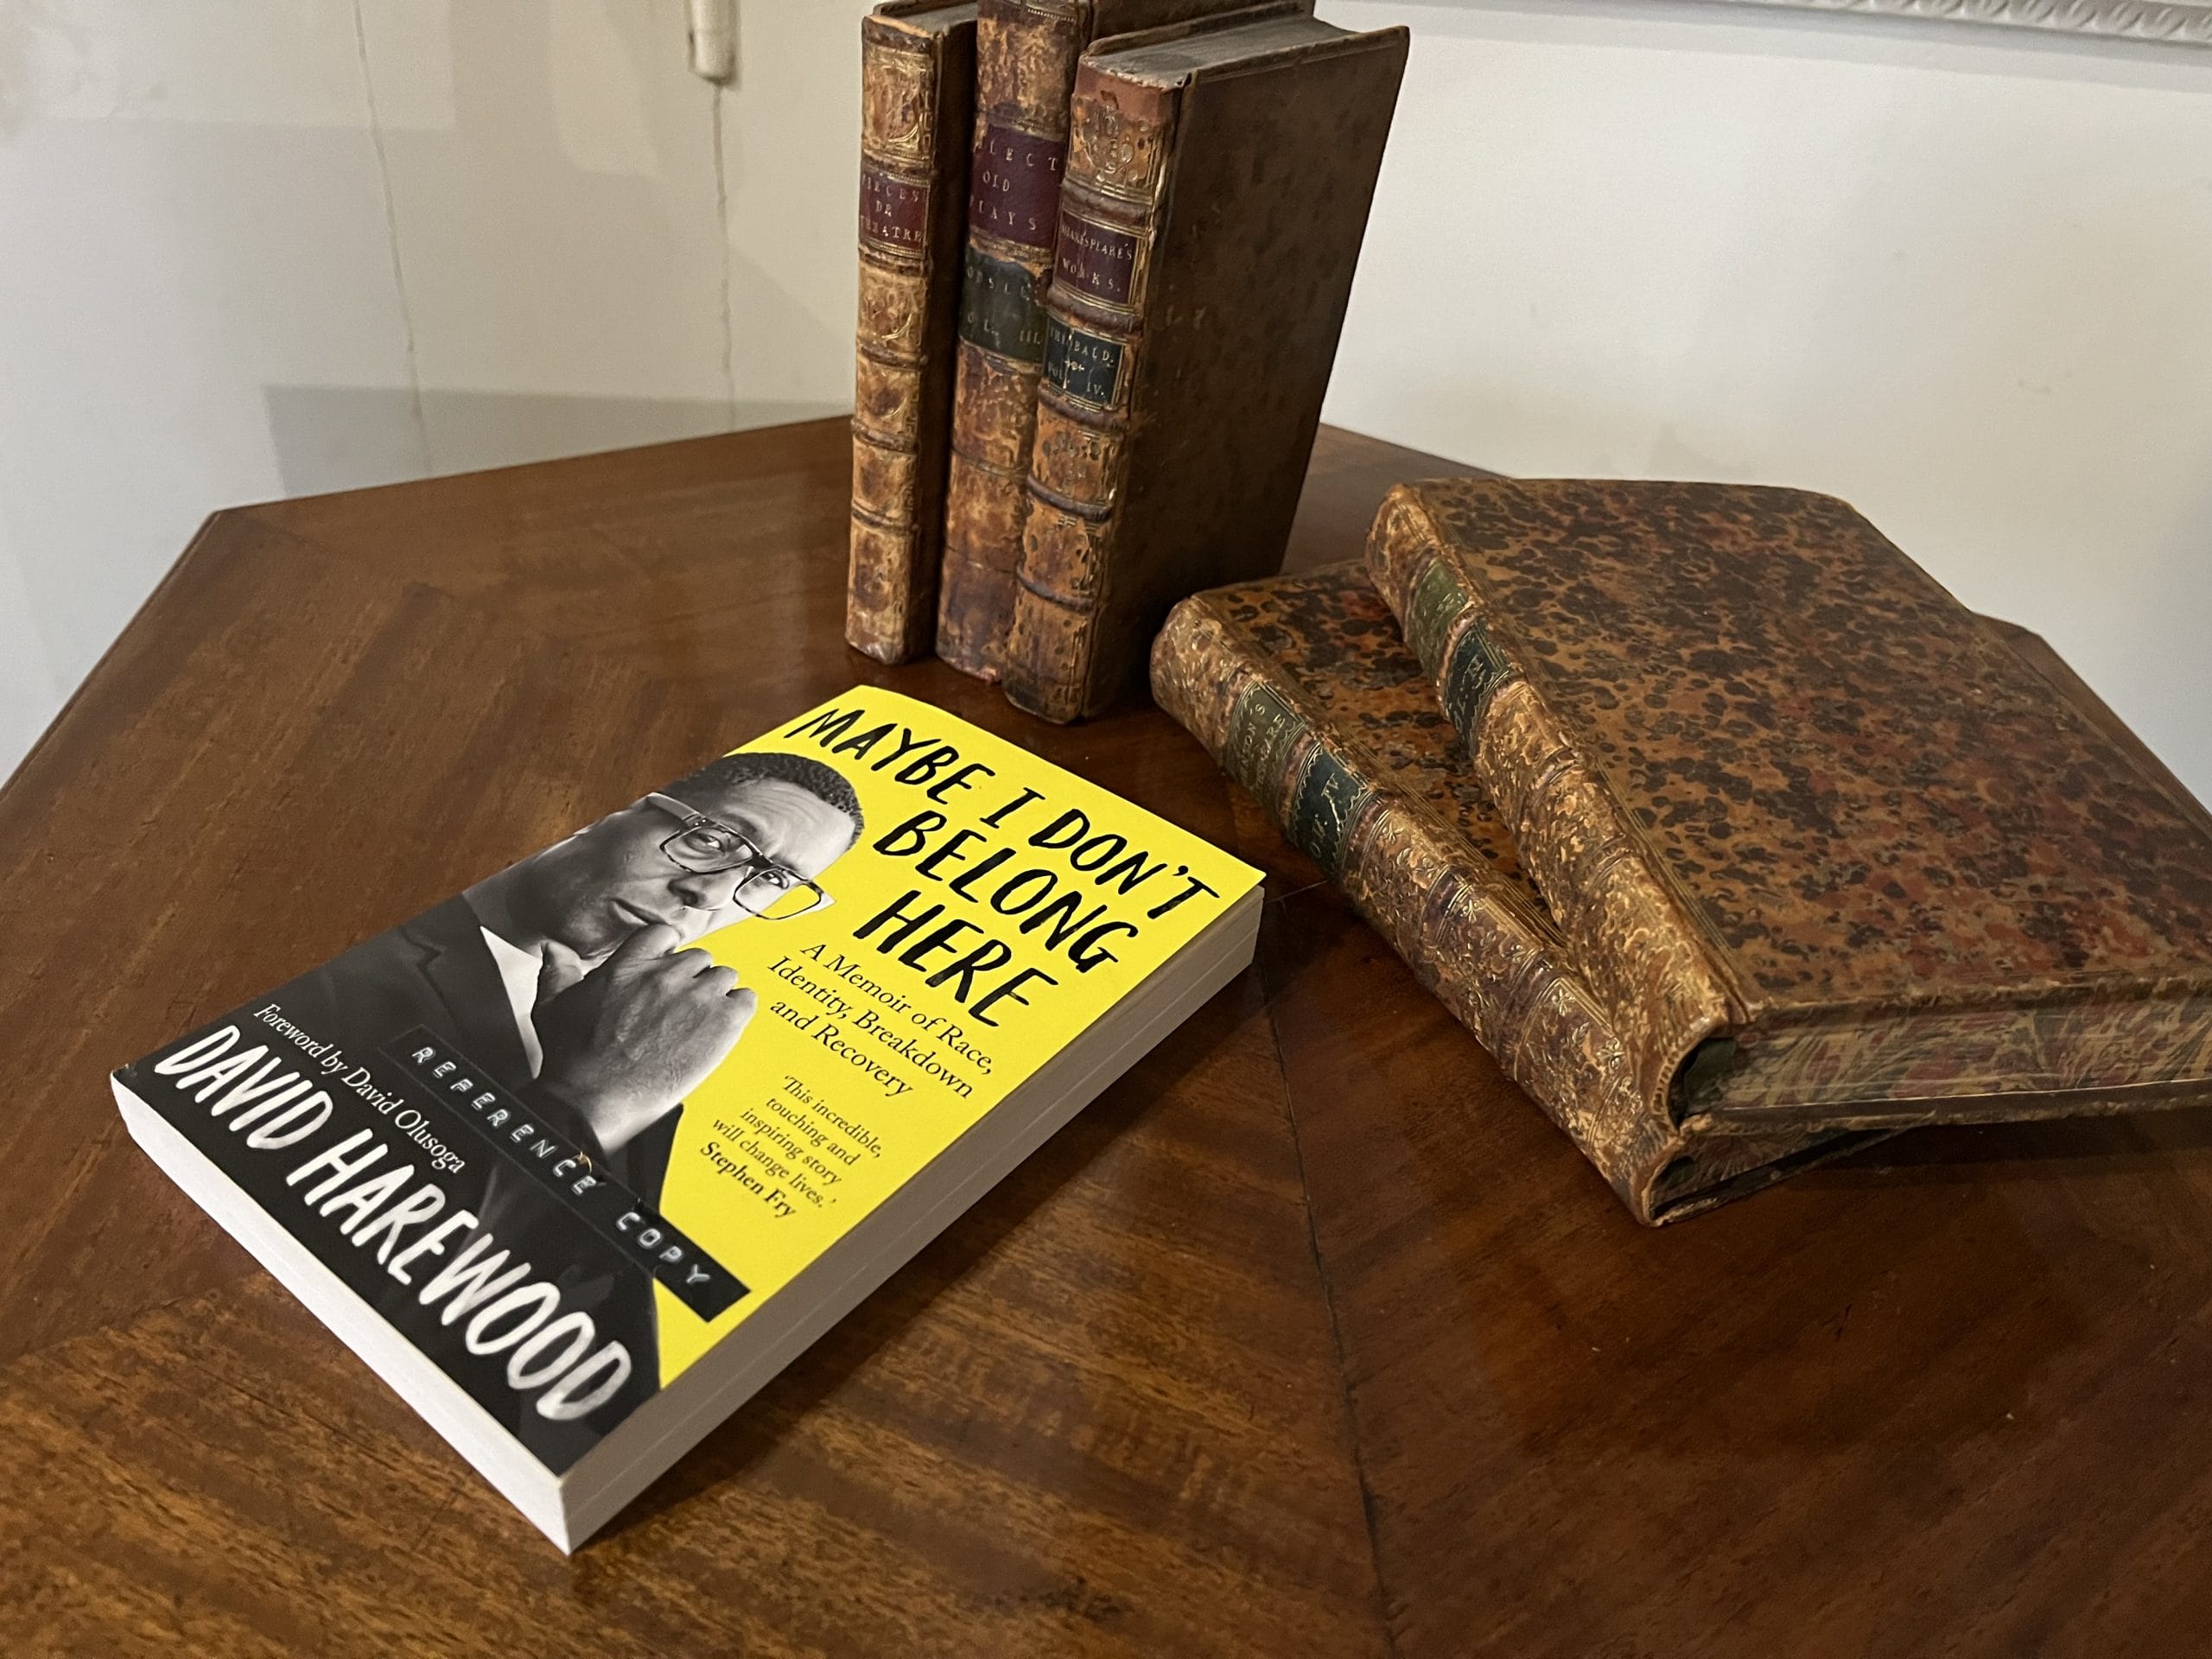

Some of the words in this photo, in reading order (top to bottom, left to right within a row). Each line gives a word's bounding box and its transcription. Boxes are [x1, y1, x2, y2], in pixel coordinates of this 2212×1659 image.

[982, 170, 1010, 192] OLD
[784, 708, 995, 804] MAYBE
[979, 786, 1046, 830] I
[1028, 808, 1220, 921] DON'T
[873, 810, 1139, 973] BELONG
[800, 943, 827, 963] A
[823, 954, 912, 1014] Memoir
[912, 1010, 947, 1032] of
[937, 1024, 993, 1075] Race,
[852, 889, 1059, 1027] HERE
[253, 1002, 334, 1058] Foreword
[321, 1049, 348, 1076] by
[340, 1066, 404, 1115] David
[394, 1109, 466, 1174] Olusoga
[768, 955, 854, 1020] Identity,
[852, 1009, 974, 1099] Breakdown
[770, 1000, 820, 1032] and
[812, 1023, 913, 1098] Recovery
[411, 1046, 598, 1196] REFERENCE
[615, 1211, 710, 1285] COPY
[700, 1141, 766, 1196] Stephen
[764, 1188, 797, 1219] Fry
[712, 1118, 745, 1143] will
[739, 1136, 791, 1180] change
[741, 1107, 804, 1160] inspiring
[803, 1154, 842, 1187] story
[766, 1096, 829, 1148] touching
[827, 1143, 862, 1166] and
[811, 1099, 882, 1159] incredible,
[154, 1024, 334, 1150] DAVID
[286, 1128, 632, 1421] HAREWOOD
